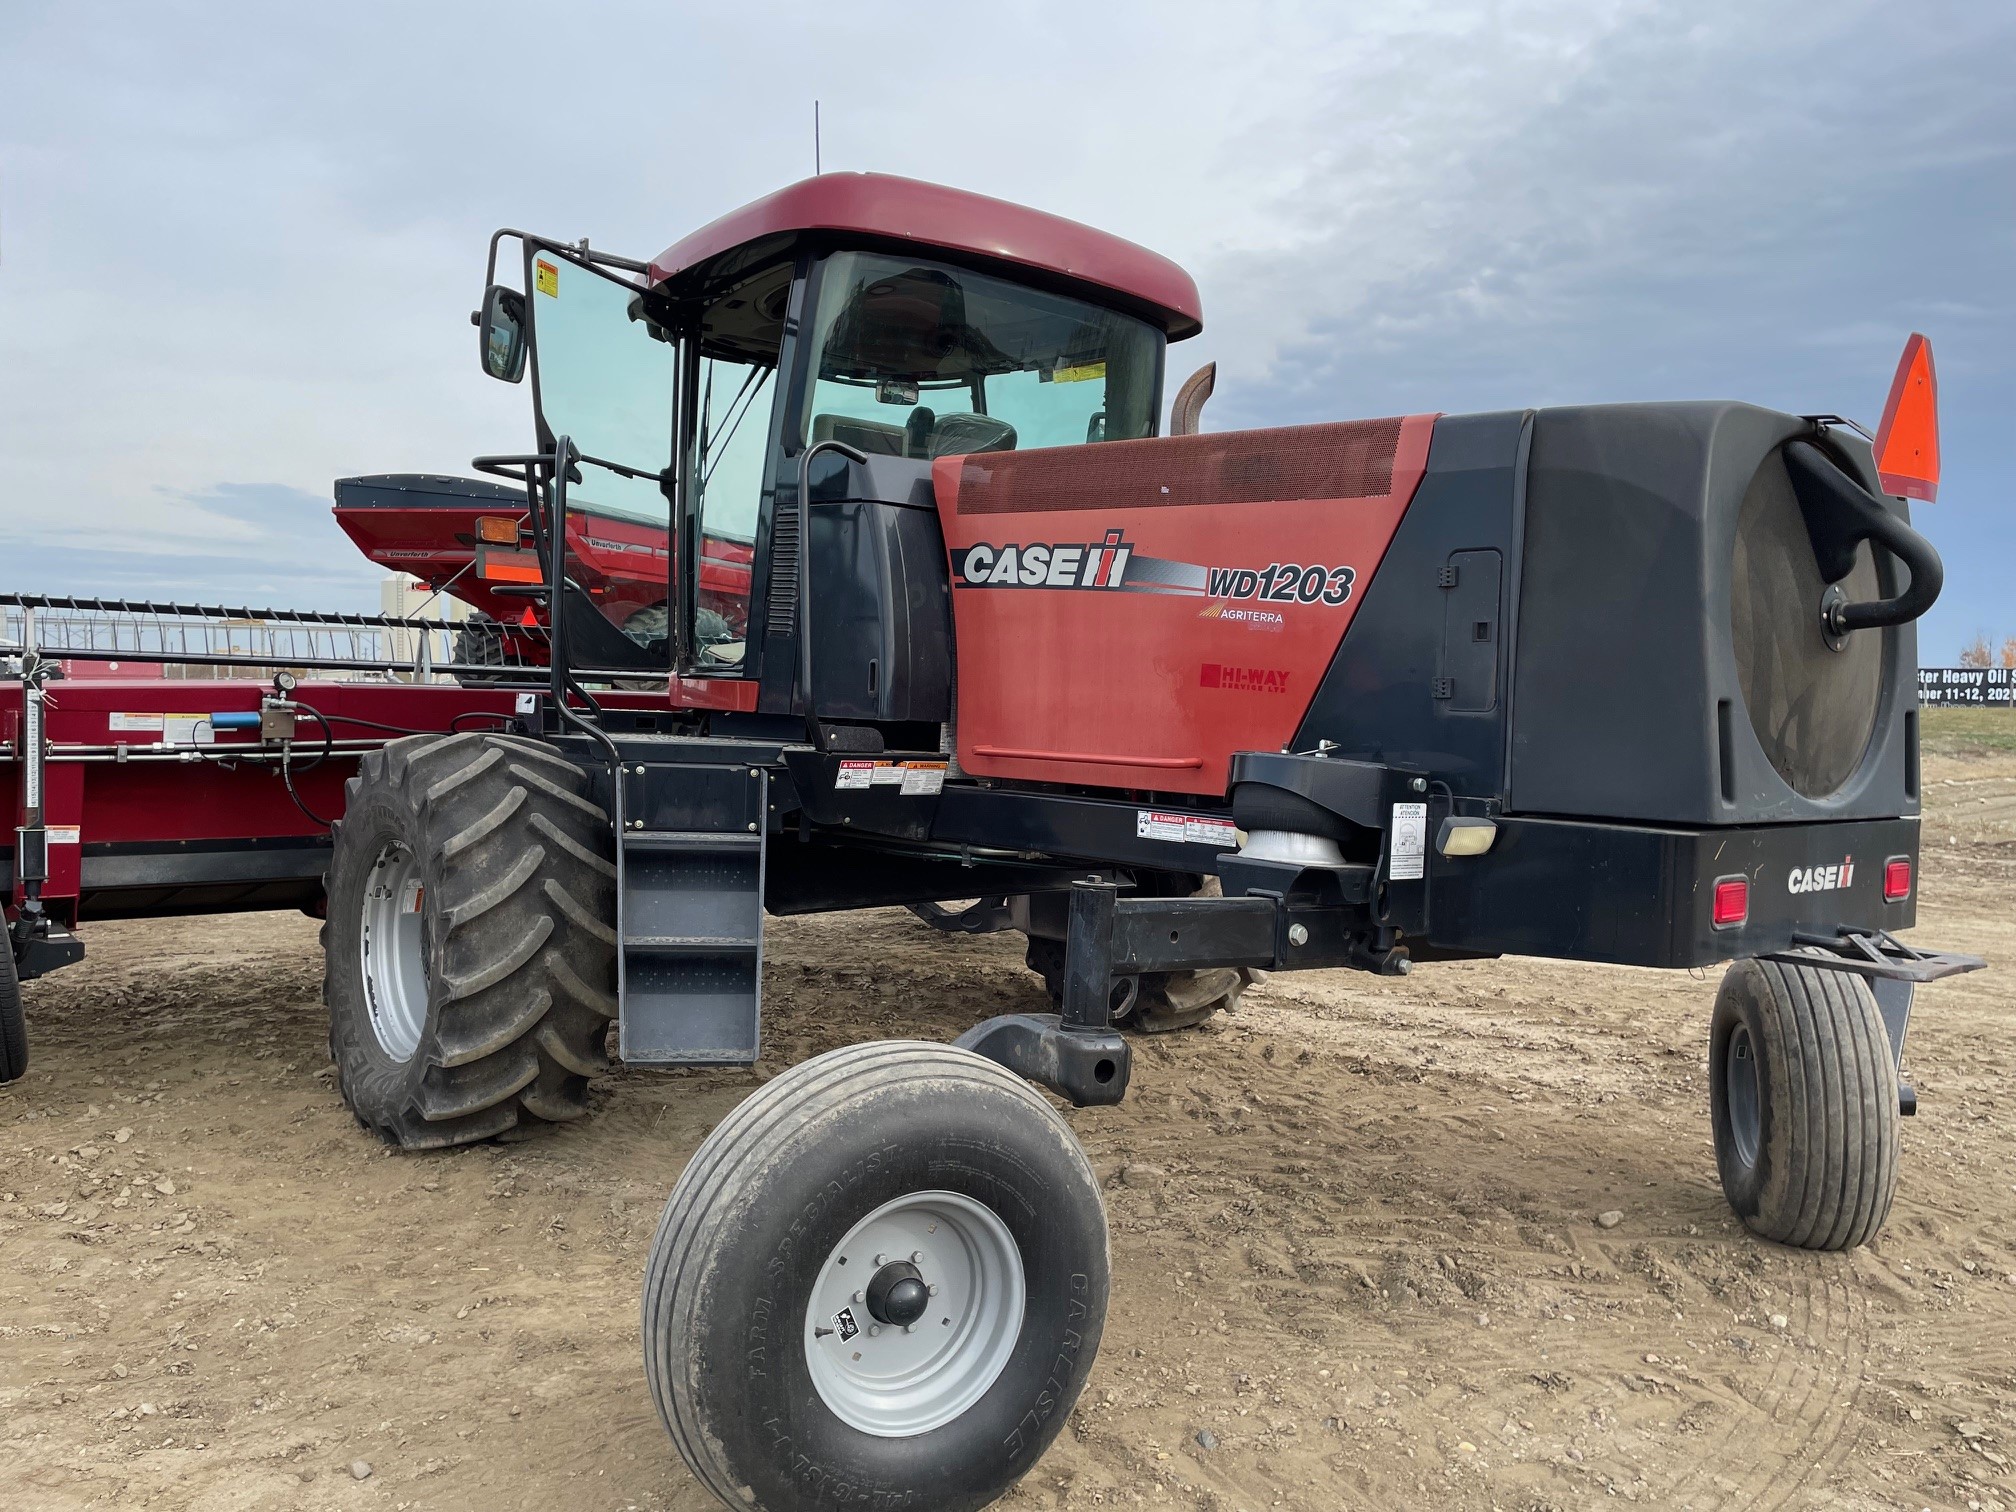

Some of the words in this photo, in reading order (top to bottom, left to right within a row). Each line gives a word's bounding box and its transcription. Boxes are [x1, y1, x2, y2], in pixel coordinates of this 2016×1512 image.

[963, 545, 1083, 586] CASE
[1208, 563, 1356, 606] WD1203
[1220, 609, 1284, 624] AGRITERRA
[1222, 667, 1291, 687] HI-WAY
[1918, 669, 1939, 684] ter
[1942, 669, 1983, 686] Heavy
[1987, 669, 2008, 684] Oil
[1945, 687, 1984, 702] 11-12,
[1159, 813, 1183, 823] DANGER
[1788, 866, 1838, 894] CASE
[1003, 1273, 1089, 1460] CARLISLE
